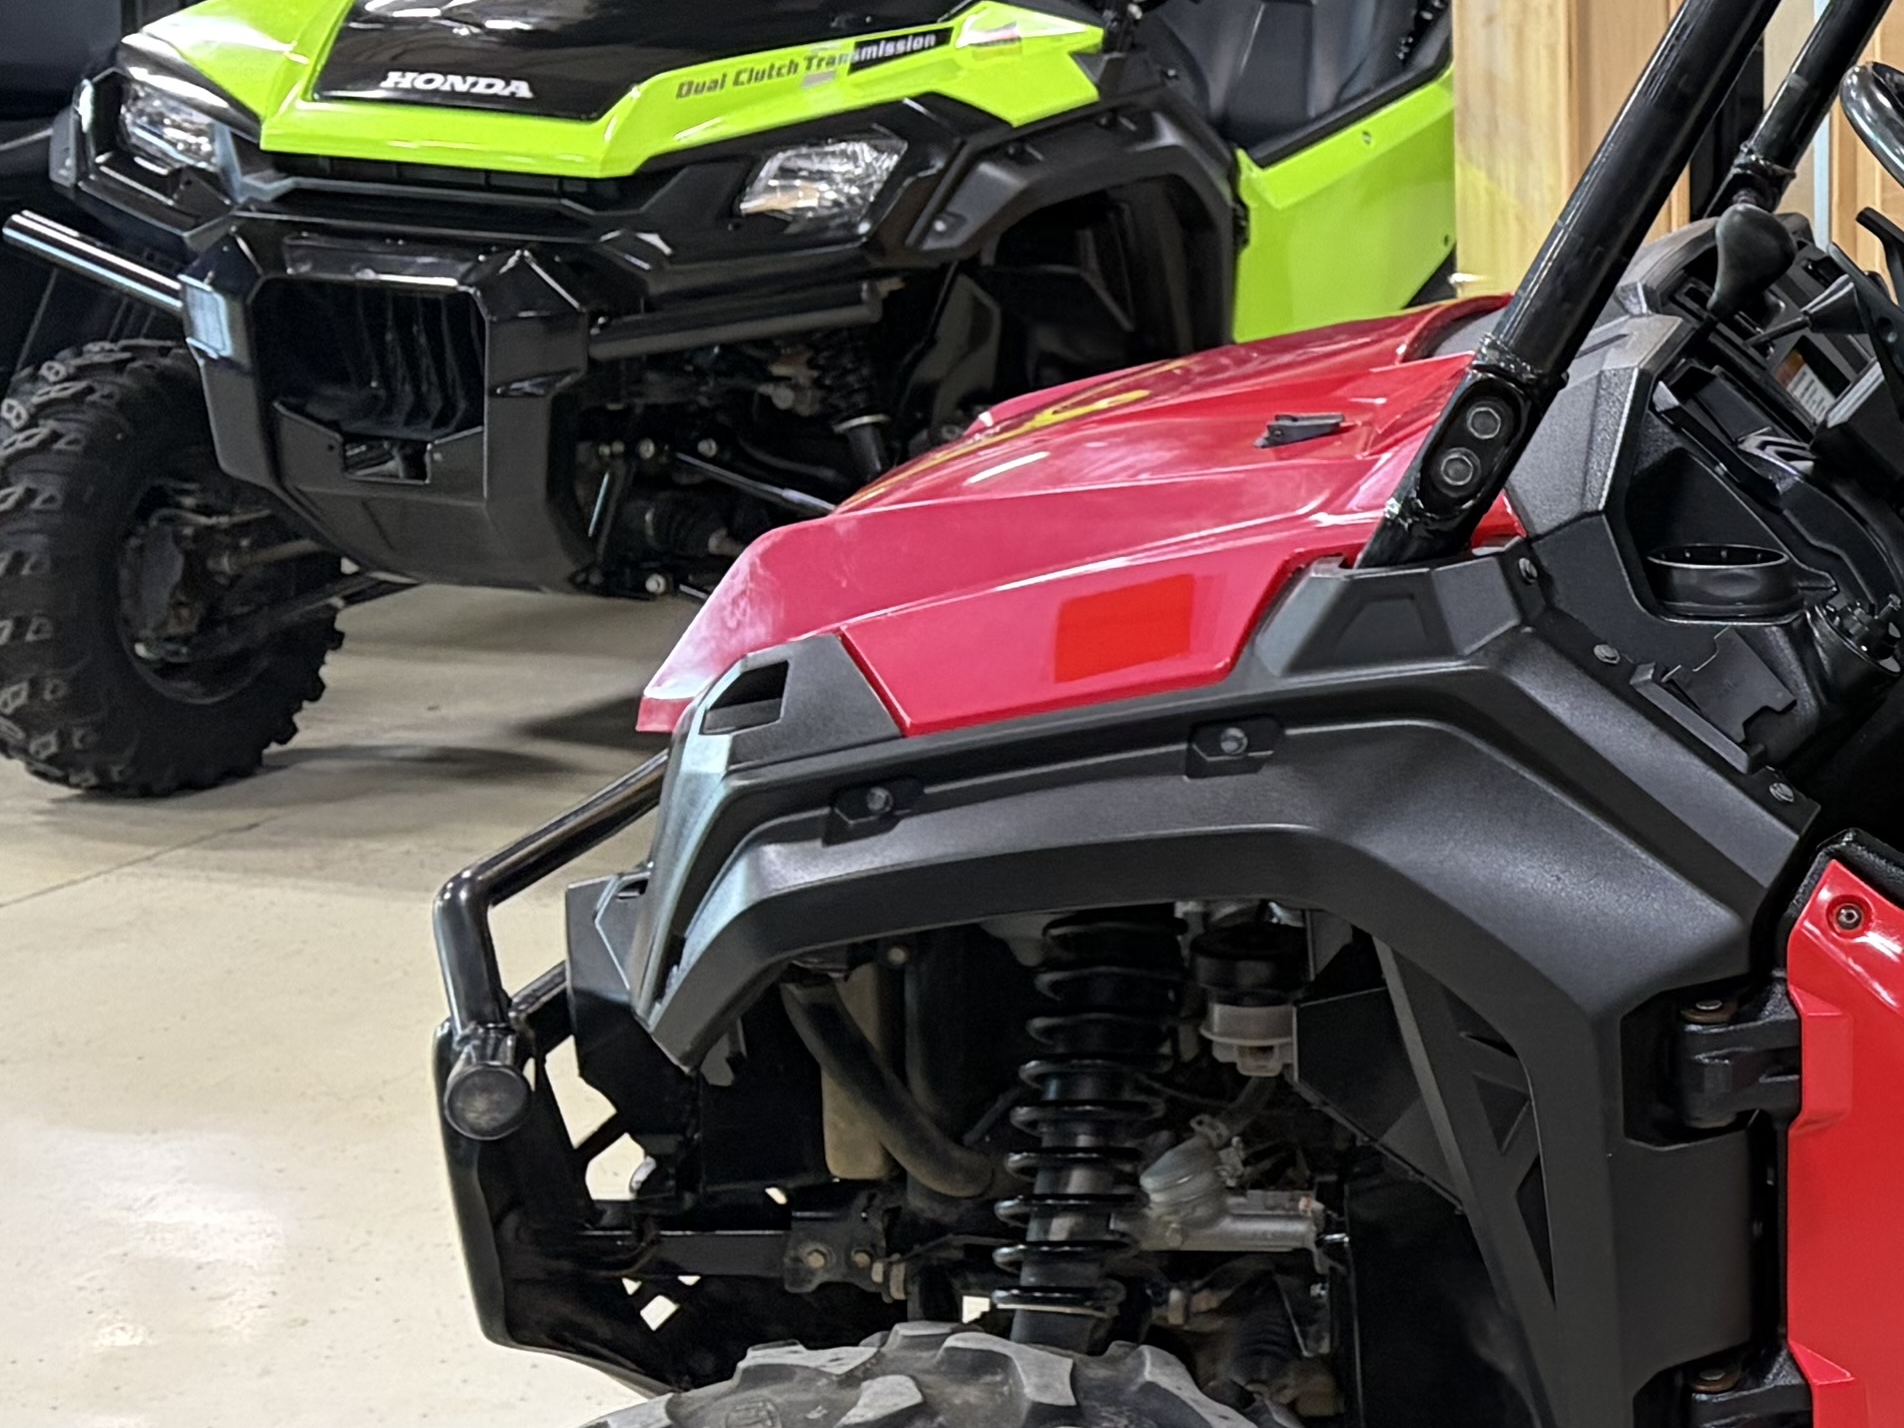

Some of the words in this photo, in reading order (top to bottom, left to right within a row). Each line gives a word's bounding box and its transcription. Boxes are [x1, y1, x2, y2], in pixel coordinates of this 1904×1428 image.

[380, 70, 534, 99] HONDA
[675, 73, 727, 100] Dual
[732, 59, 799, 87] Clutch
[803, 33, 937, 72] Transmission
